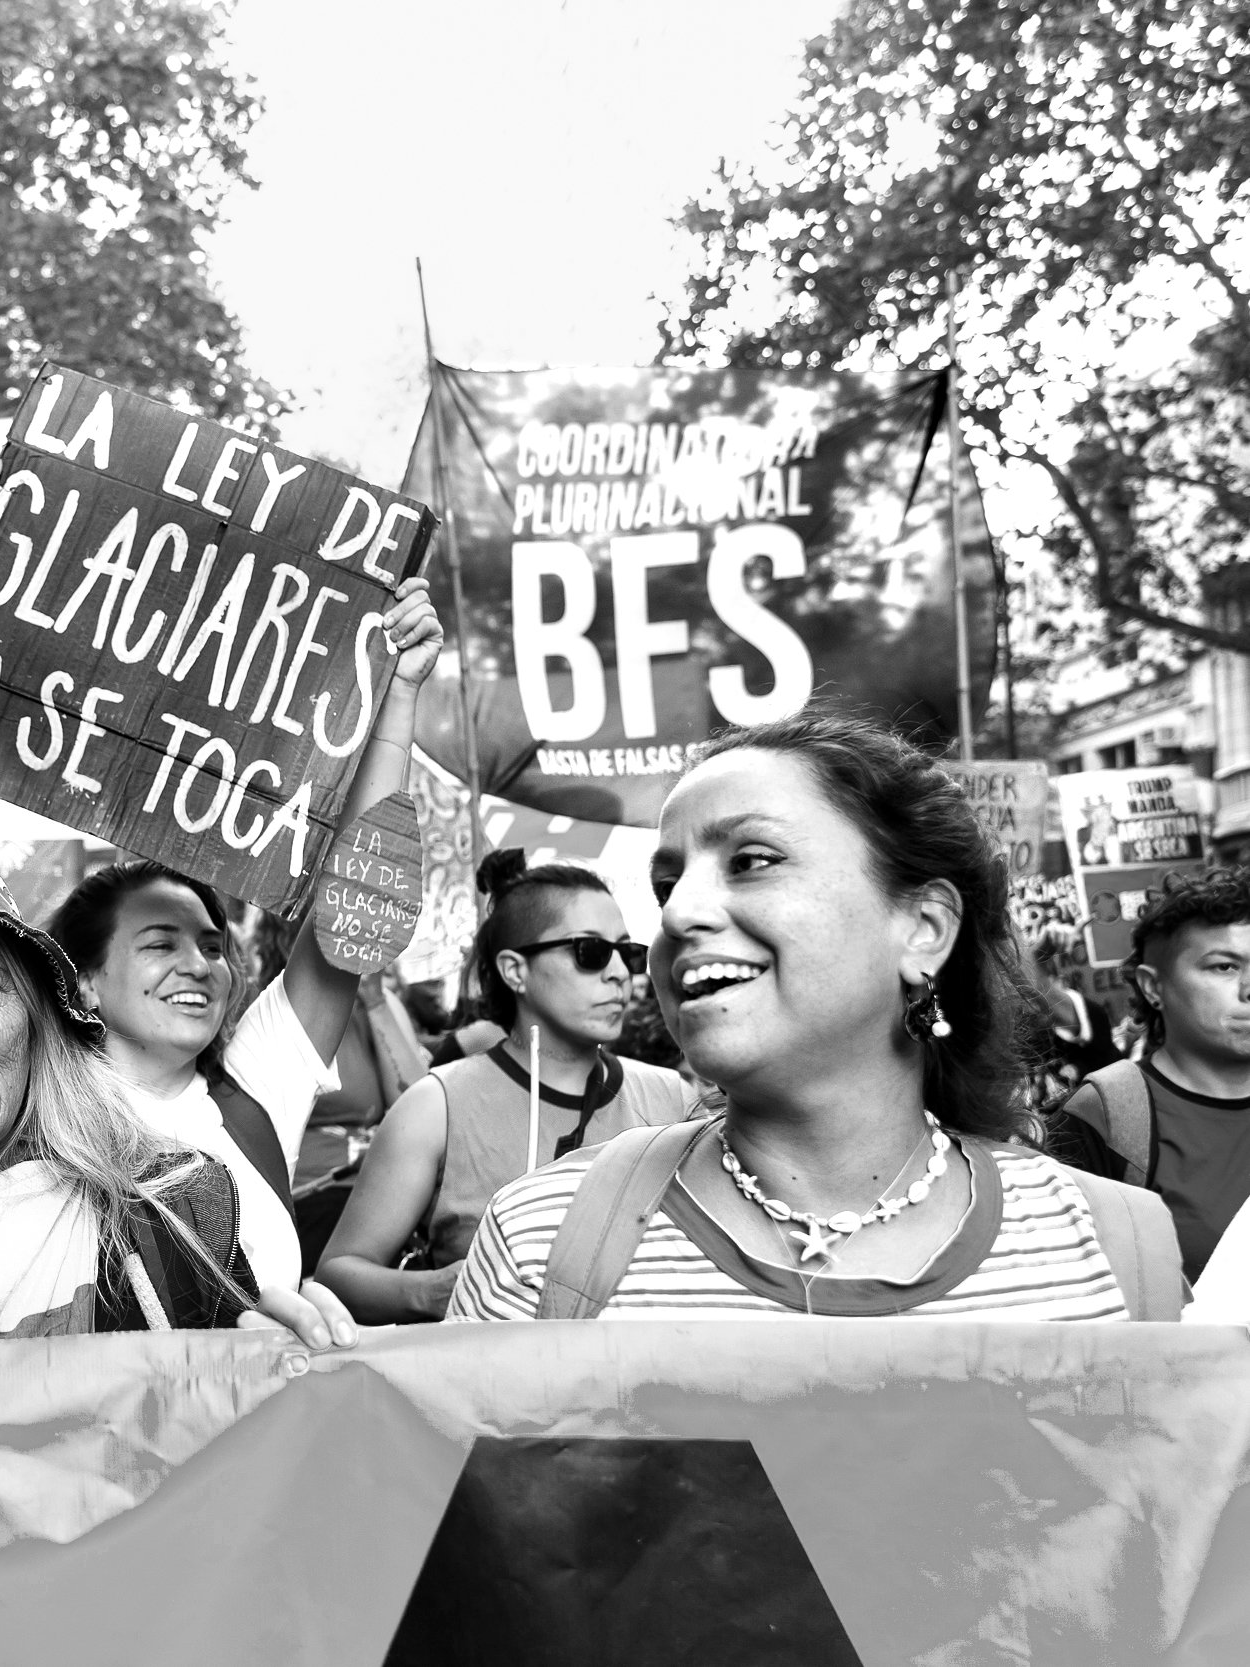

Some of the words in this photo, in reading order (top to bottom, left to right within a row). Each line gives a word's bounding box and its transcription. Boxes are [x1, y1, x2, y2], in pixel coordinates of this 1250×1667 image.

[23, 374, 115, 470] LA
[161, 421, 307, 533] LEY
[316, 485, 420, 584] DE
[511, 523, 814, 742] BFS
[15, 670, 124, 794] SE
[142, 712, 313, 877] TOCA
[352, 828, 382, 856] LA
[378, 865, 409, 890] DE
[331, 911, 362, 937] NO
[364, 920, 393, 944] SE
[333, 935, 383, 962] TOCA
